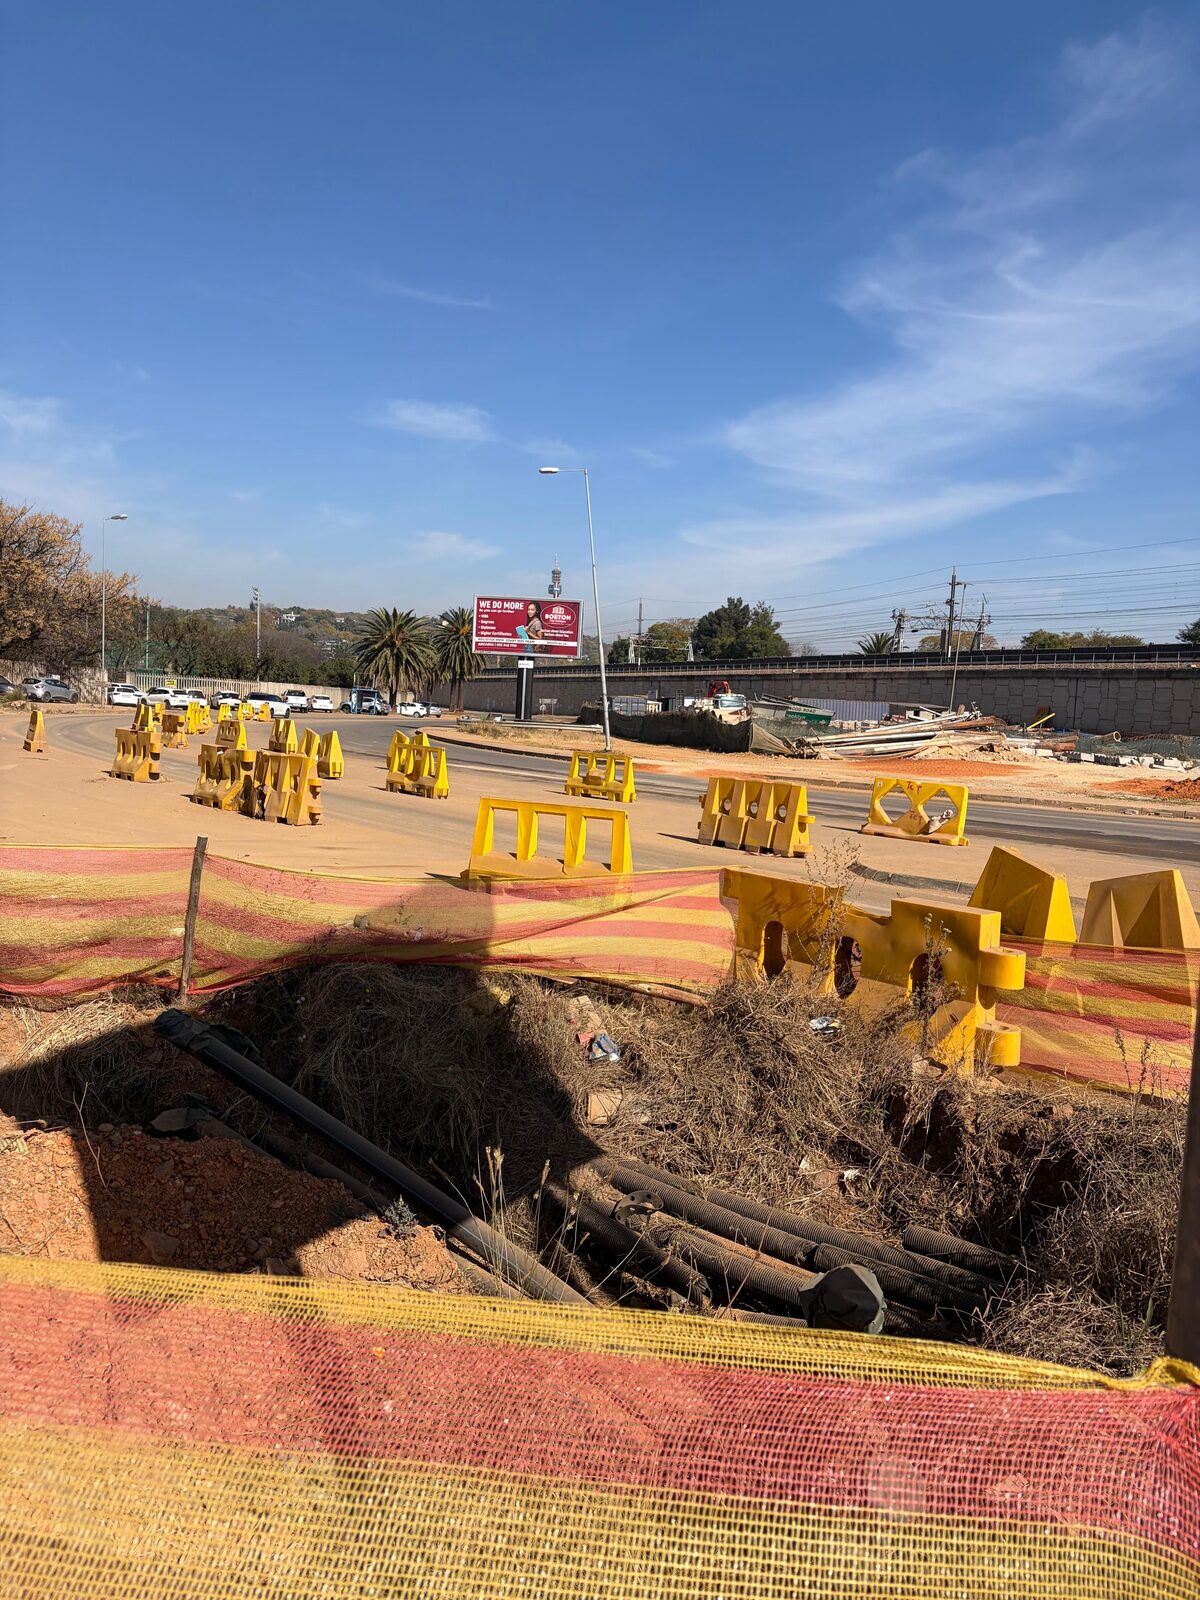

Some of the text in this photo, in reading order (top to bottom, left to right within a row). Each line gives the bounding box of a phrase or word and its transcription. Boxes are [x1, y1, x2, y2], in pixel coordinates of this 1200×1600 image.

[479, 600, 524, 610] WE DO MORE
